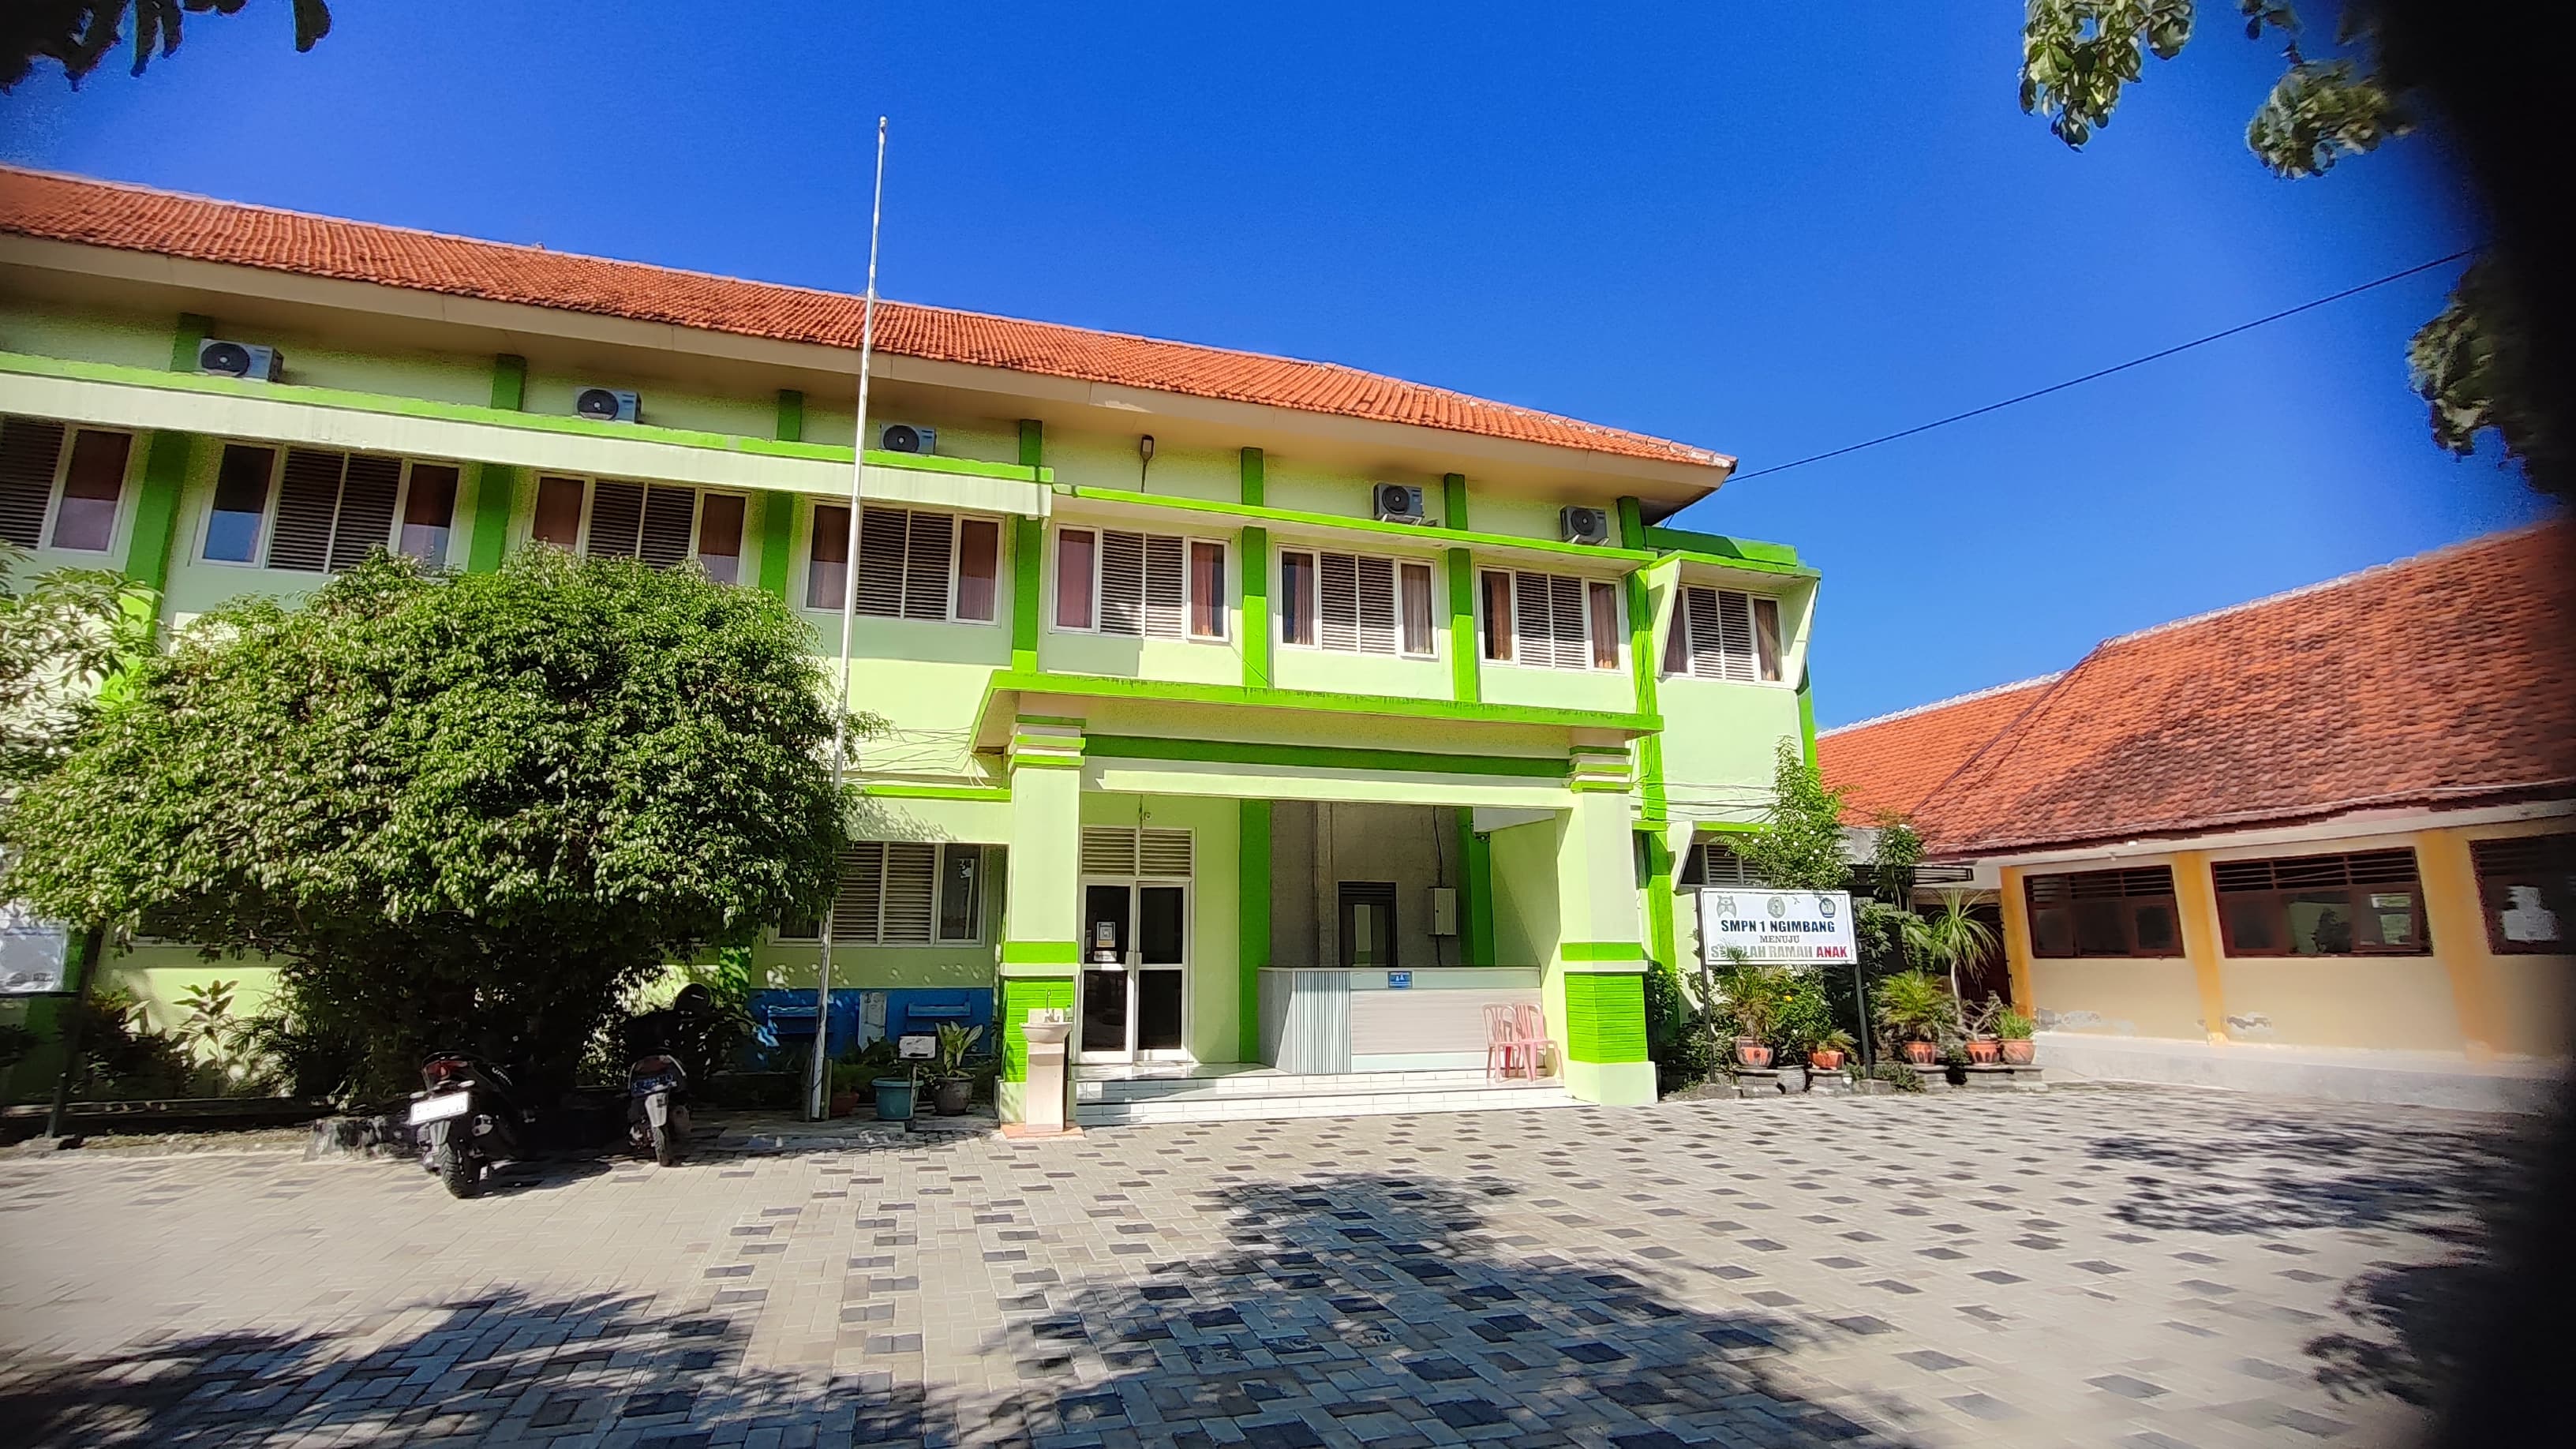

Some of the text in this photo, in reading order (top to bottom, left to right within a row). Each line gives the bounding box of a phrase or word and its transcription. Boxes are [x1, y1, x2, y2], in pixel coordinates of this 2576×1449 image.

[1721, 919, 1835, 933] SMPN 1 NGIMBANG
[1759, 934, 1799, 943] MENUJU
[1711, 945, 1766, 958] SLAH
[1816, 945, 1847, 958] ANAK
